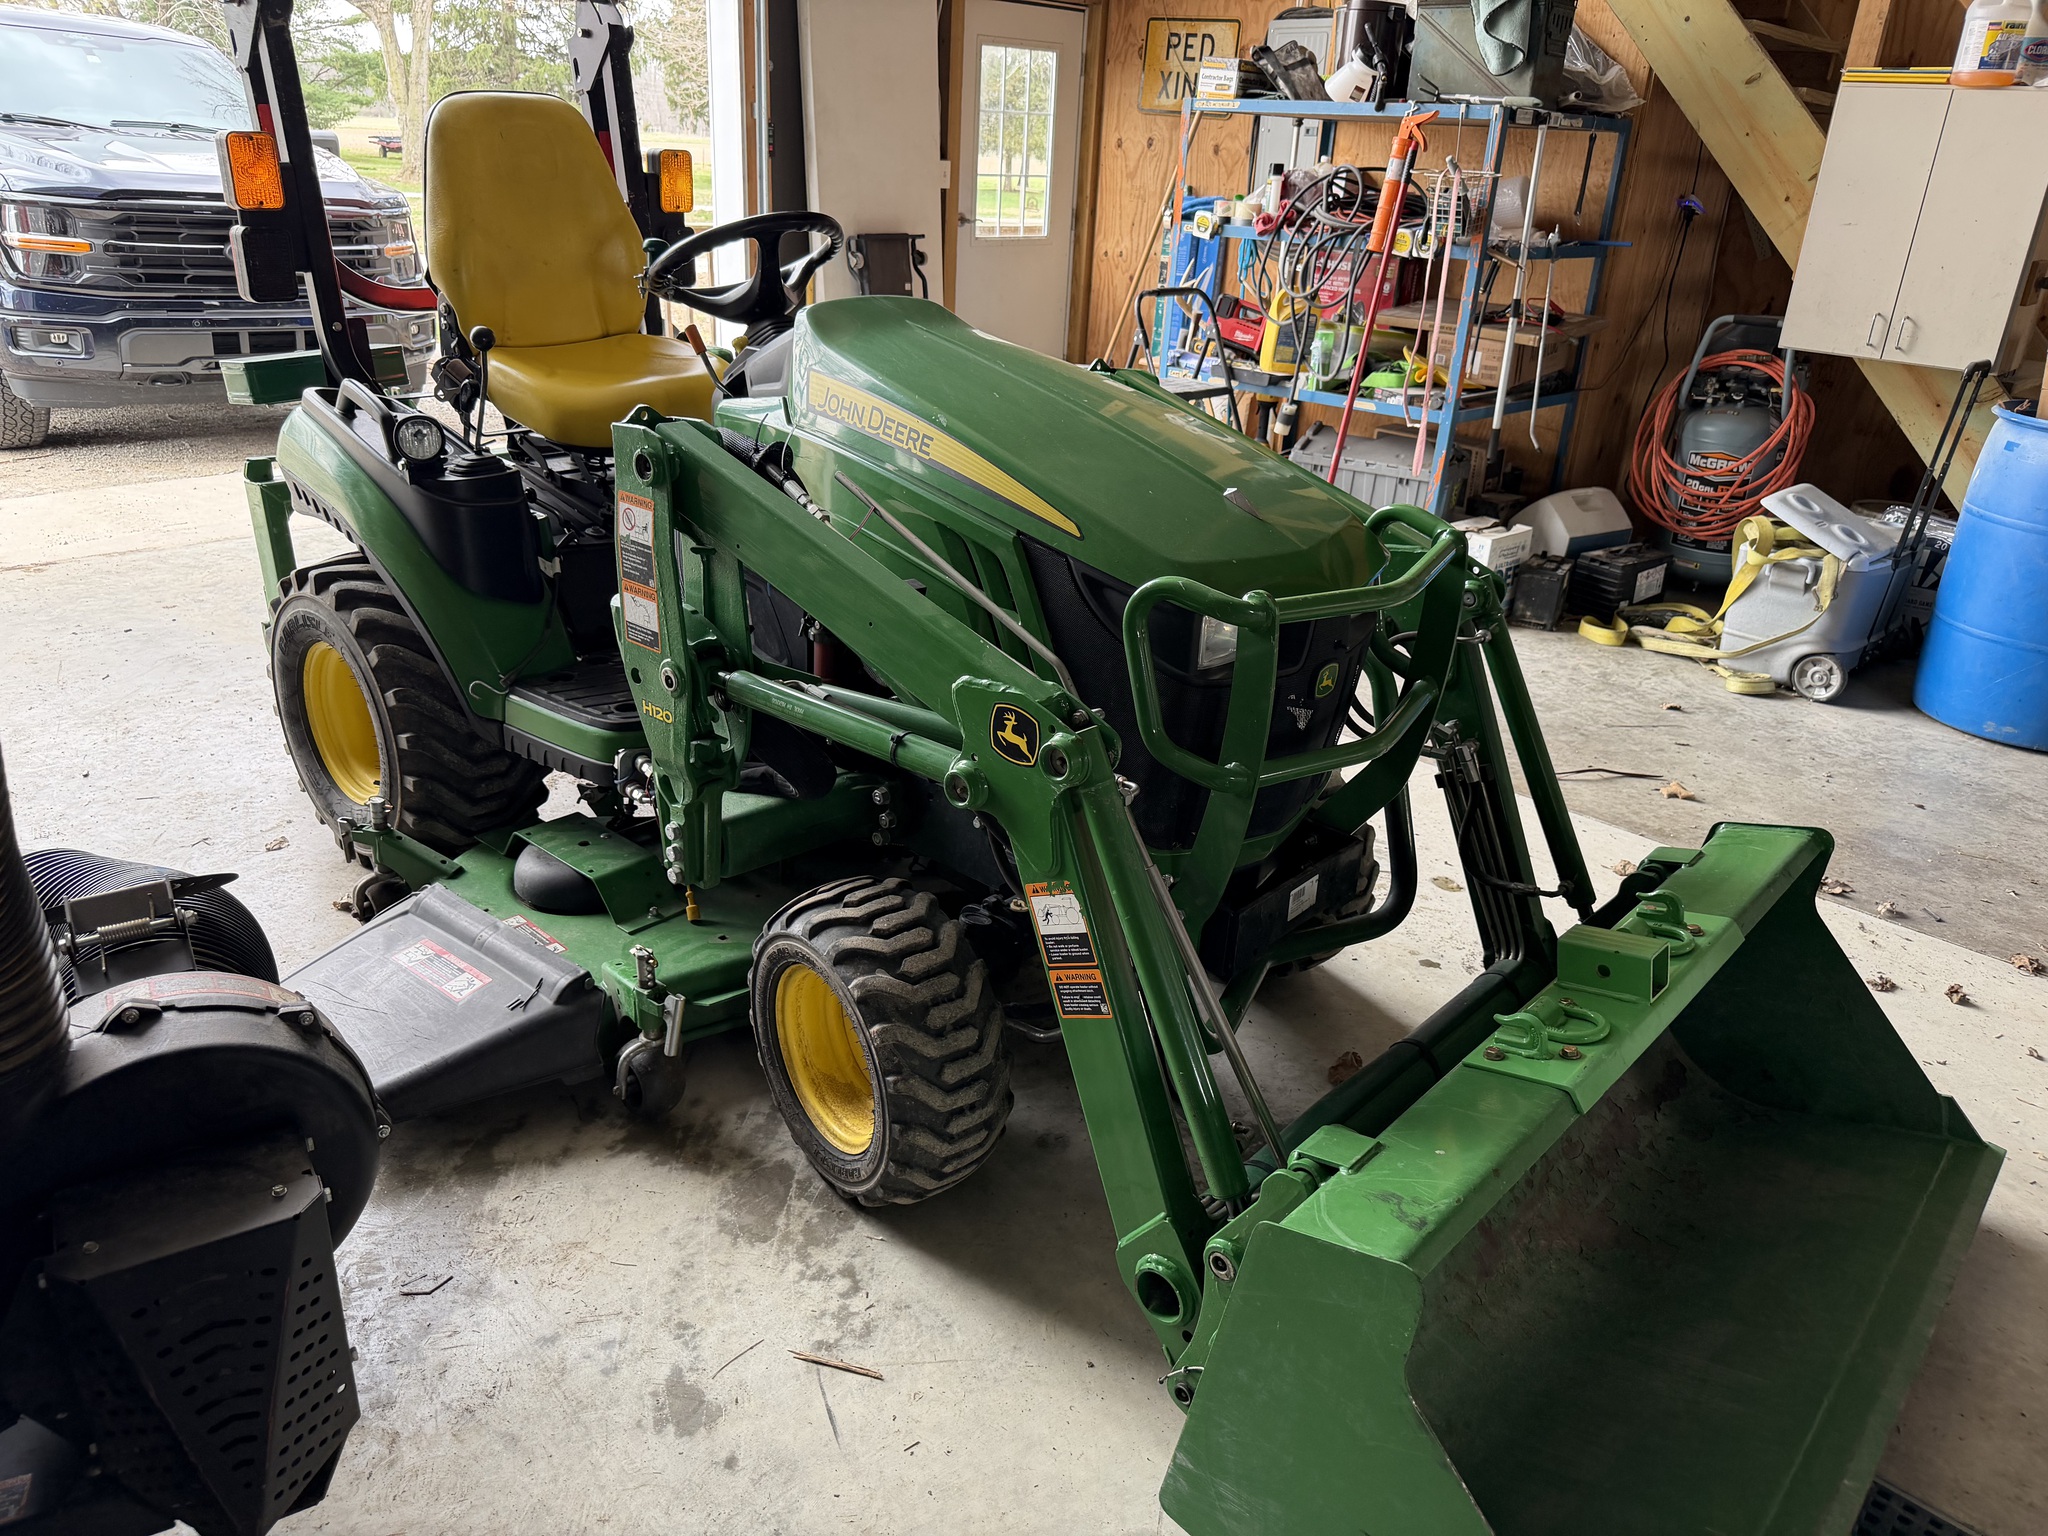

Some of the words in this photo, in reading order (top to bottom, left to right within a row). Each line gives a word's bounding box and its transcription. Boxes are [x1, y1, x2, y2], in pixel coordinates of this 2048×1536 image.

[1165, 32, 1216, 62] PED
[2027, 45, 2048, 55] CLOR
[1157, 70, 1199, 100] XIN
[1223, 75, 1234, 83] Bags
[817, 387, 866, 425] JOHN
[867, 405, 934, 457] DEERE
[625, 495, 653, 510] WARNING
[1934, 540, 1948, 551] 20
[629, 585, 656, 601] WARNING
[642, 697, 673, 724] H120
[1064, 973, 1097, 981] WARNING
